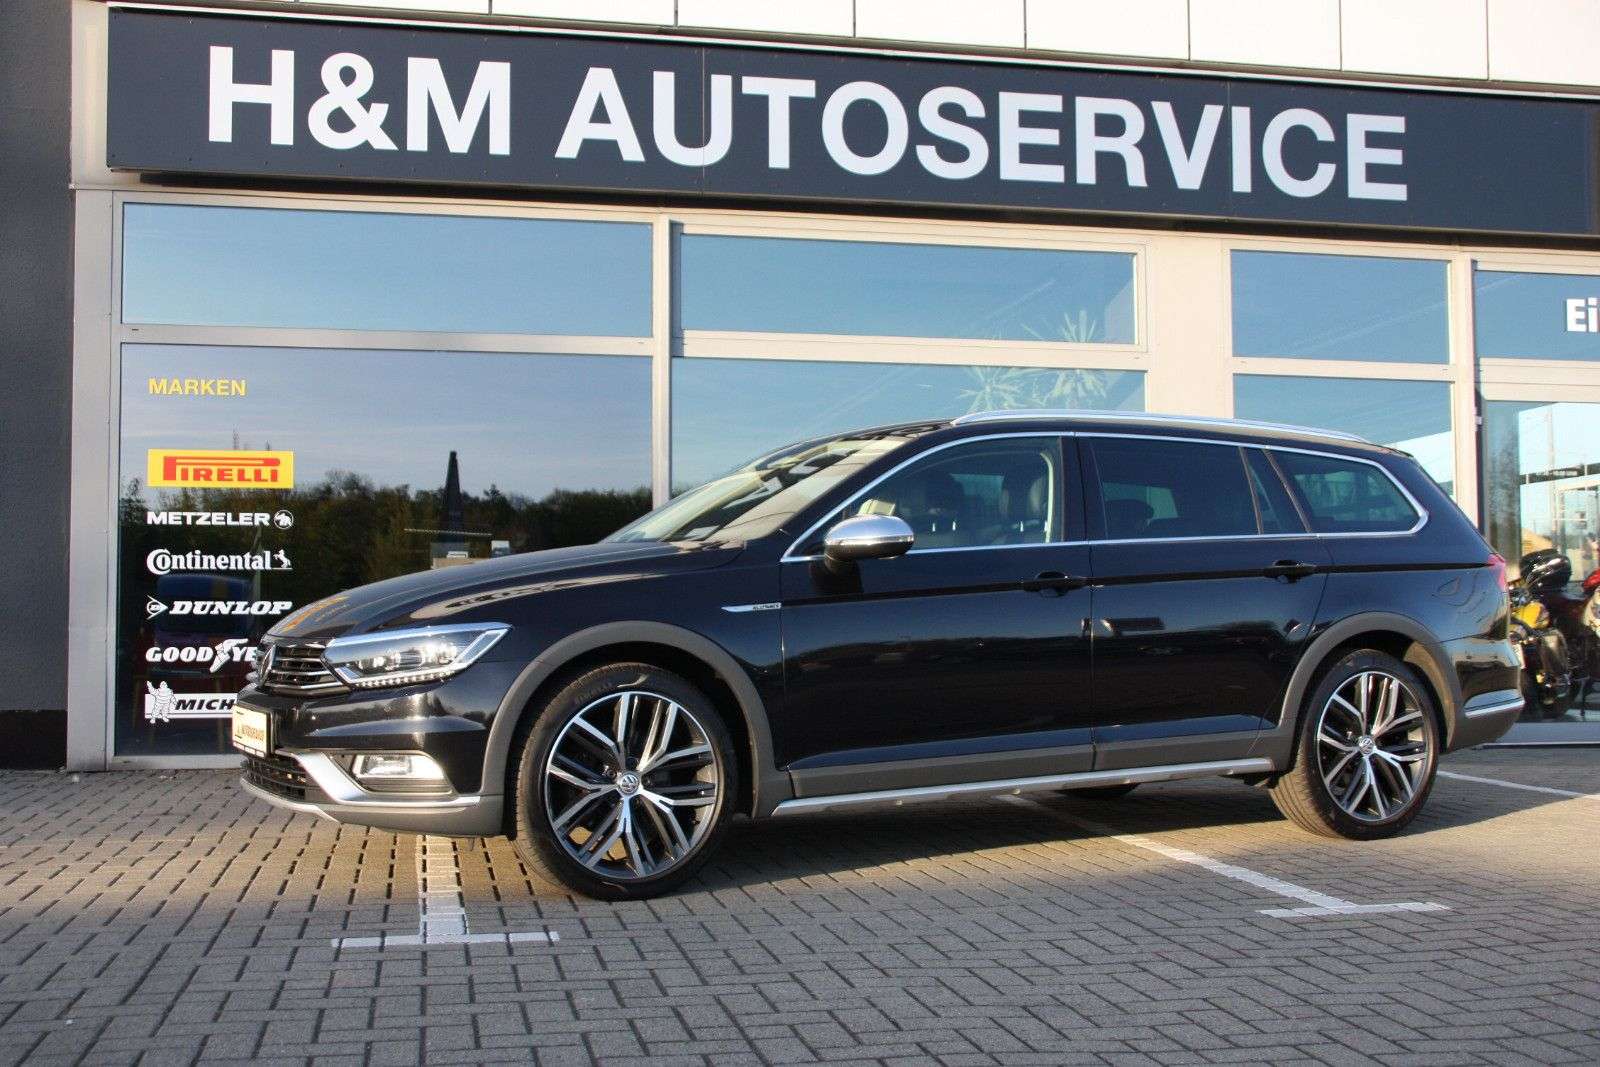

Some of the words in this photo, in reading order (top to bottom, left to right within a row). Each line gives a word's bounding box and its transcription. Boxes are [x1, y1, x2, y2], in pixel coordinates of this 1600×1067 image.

[209, 46, 511, 155] H&M
[555, 67, 1408, 202] AUTOSERVICE
[148, 378, 247, 396] MARKEN
[163, 455, 280, 482] PIRELLI
[146, 511, 271, 526] METZELER
[146, 548, 273, 575] Continental
[169, 600, 293, 615] DUNLOP
[145, 646, 258, 662] GOODYE
[174, 699, 236, 710] MICH
